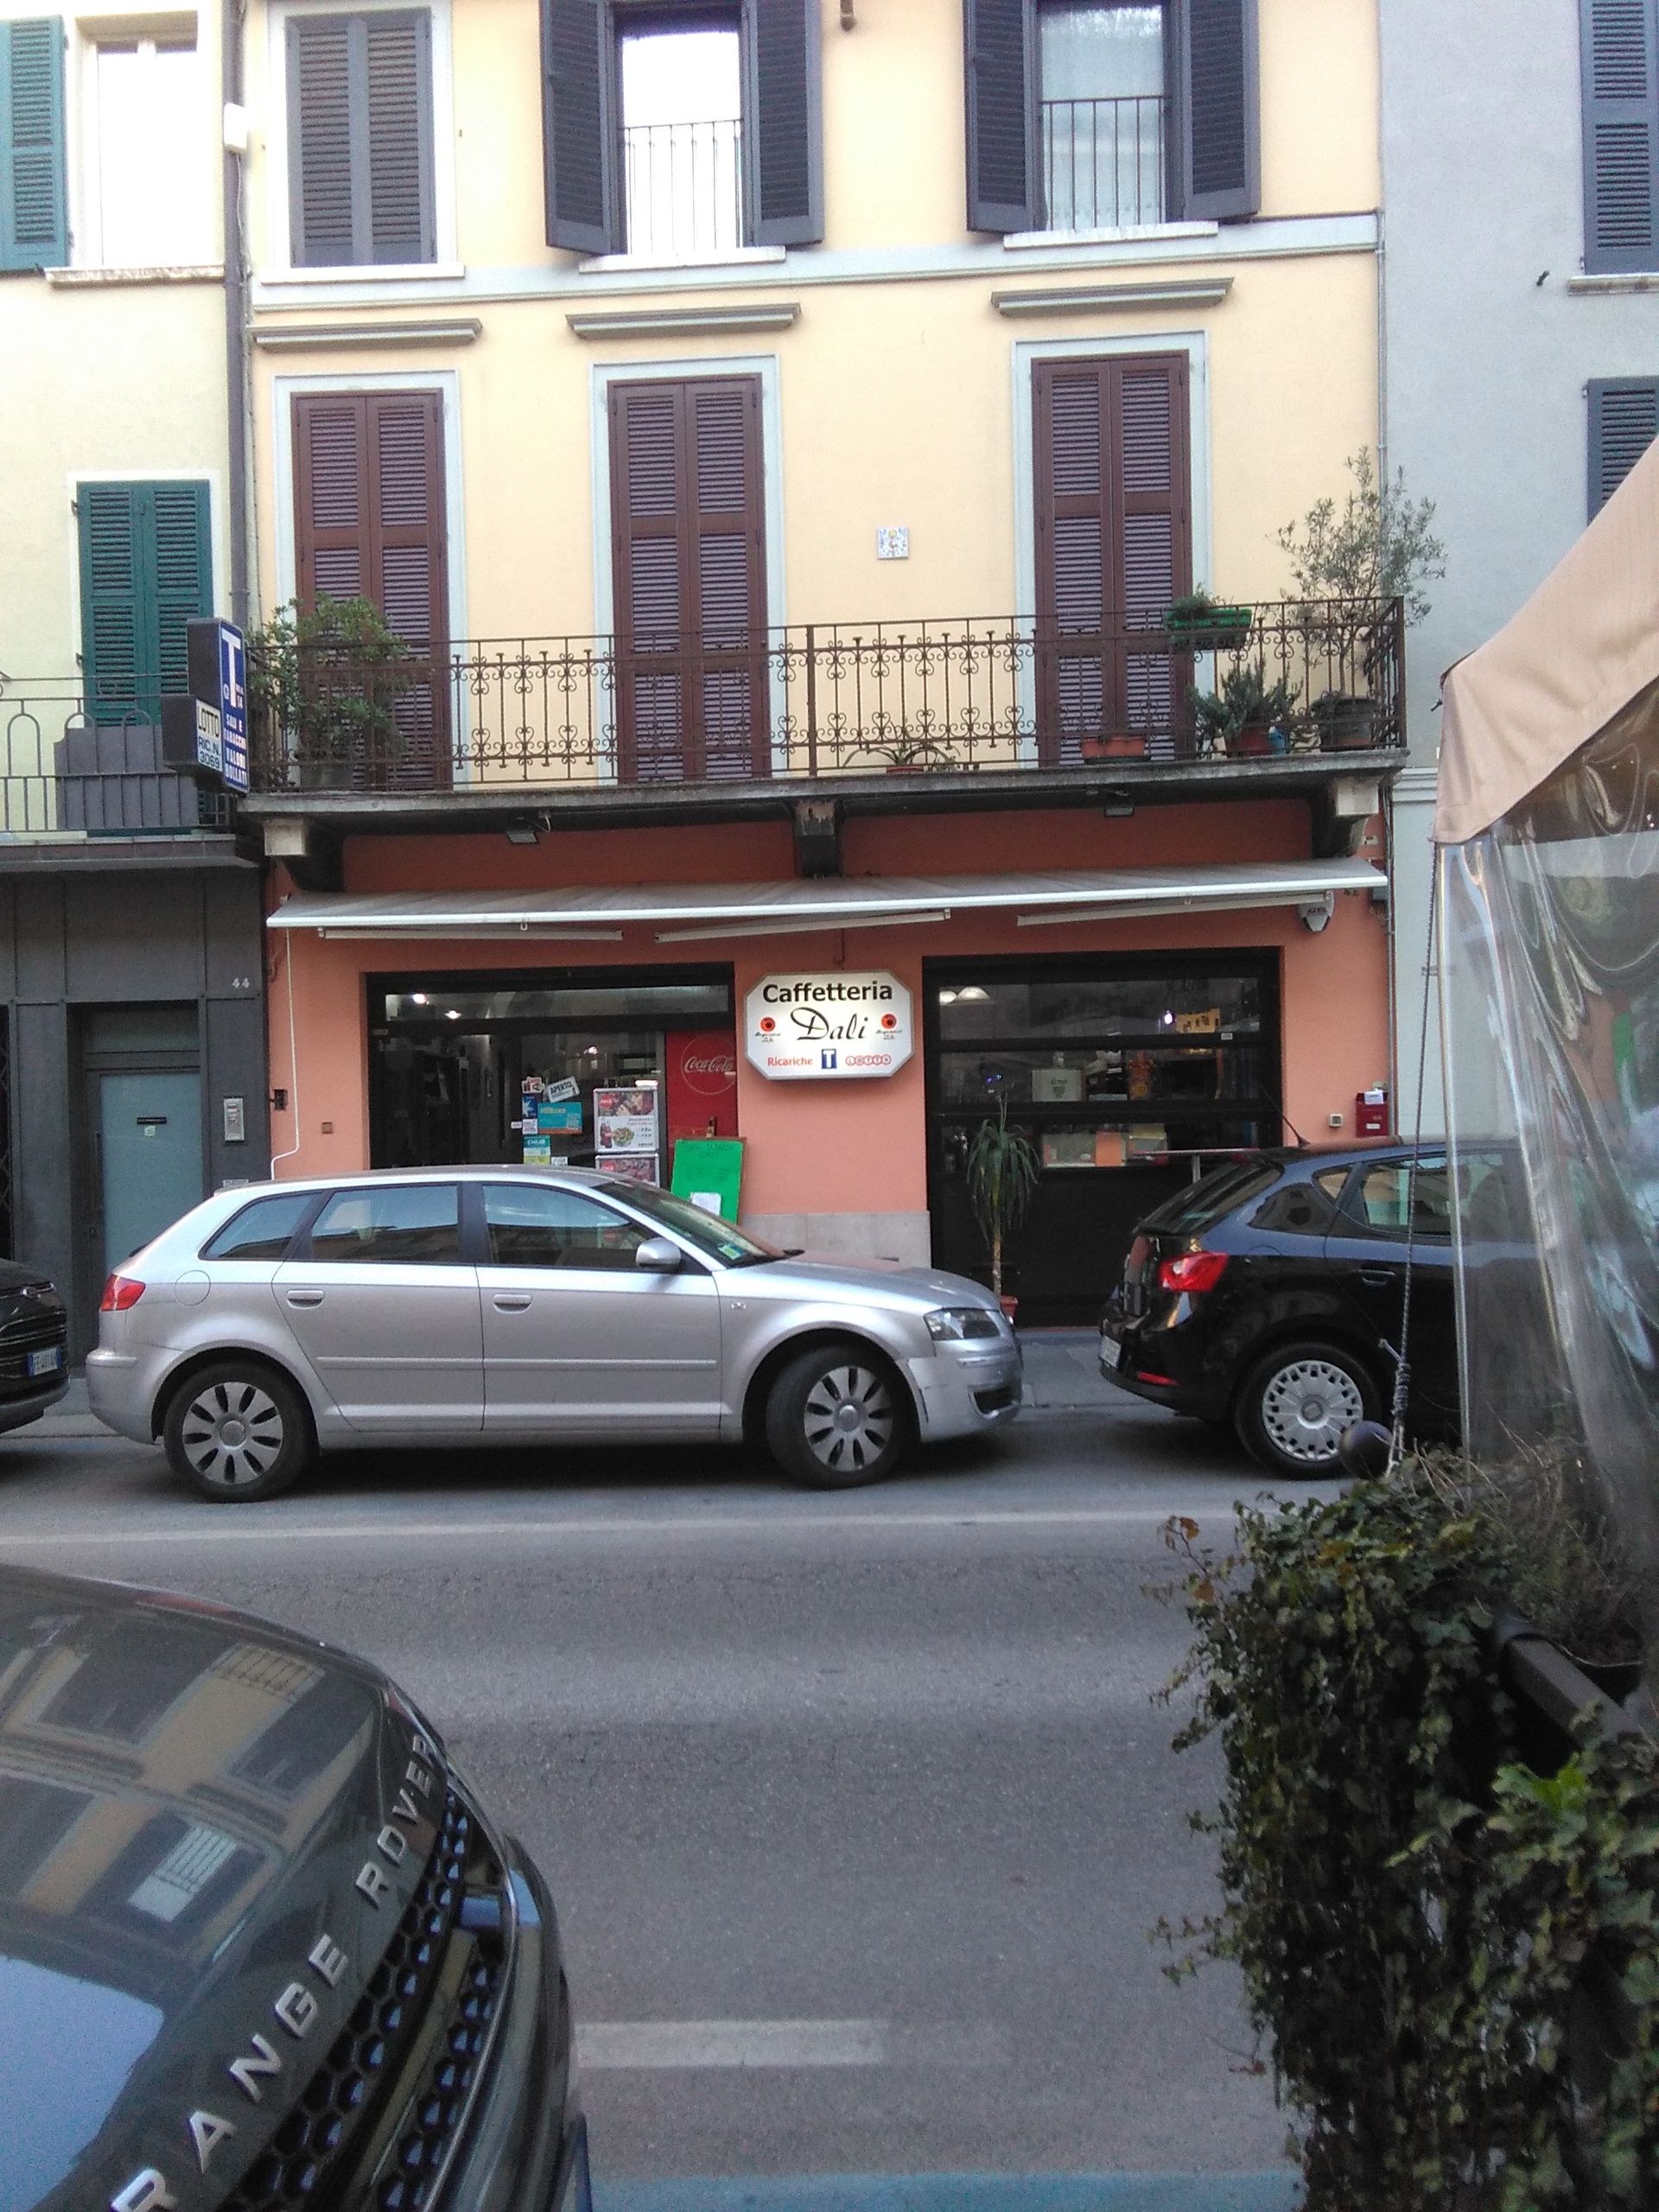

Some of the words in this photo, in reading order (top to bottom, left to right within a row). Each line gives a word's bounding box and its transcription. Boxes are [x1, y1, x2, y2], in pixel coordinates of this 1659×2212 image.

[222, 627, 242, 709] T
[198, 705, 219, 738] LOTTO
[232, 977, 250, 988] 44
[763, 981, 893, 1003] Caffetteria
[767, 1056, 813, 1066] Ricariche
[823, 1050, 836, 1070] T
[111, 1933, 348, 2212] RANGE
[354, 1733, 437, 1910] ROVER
